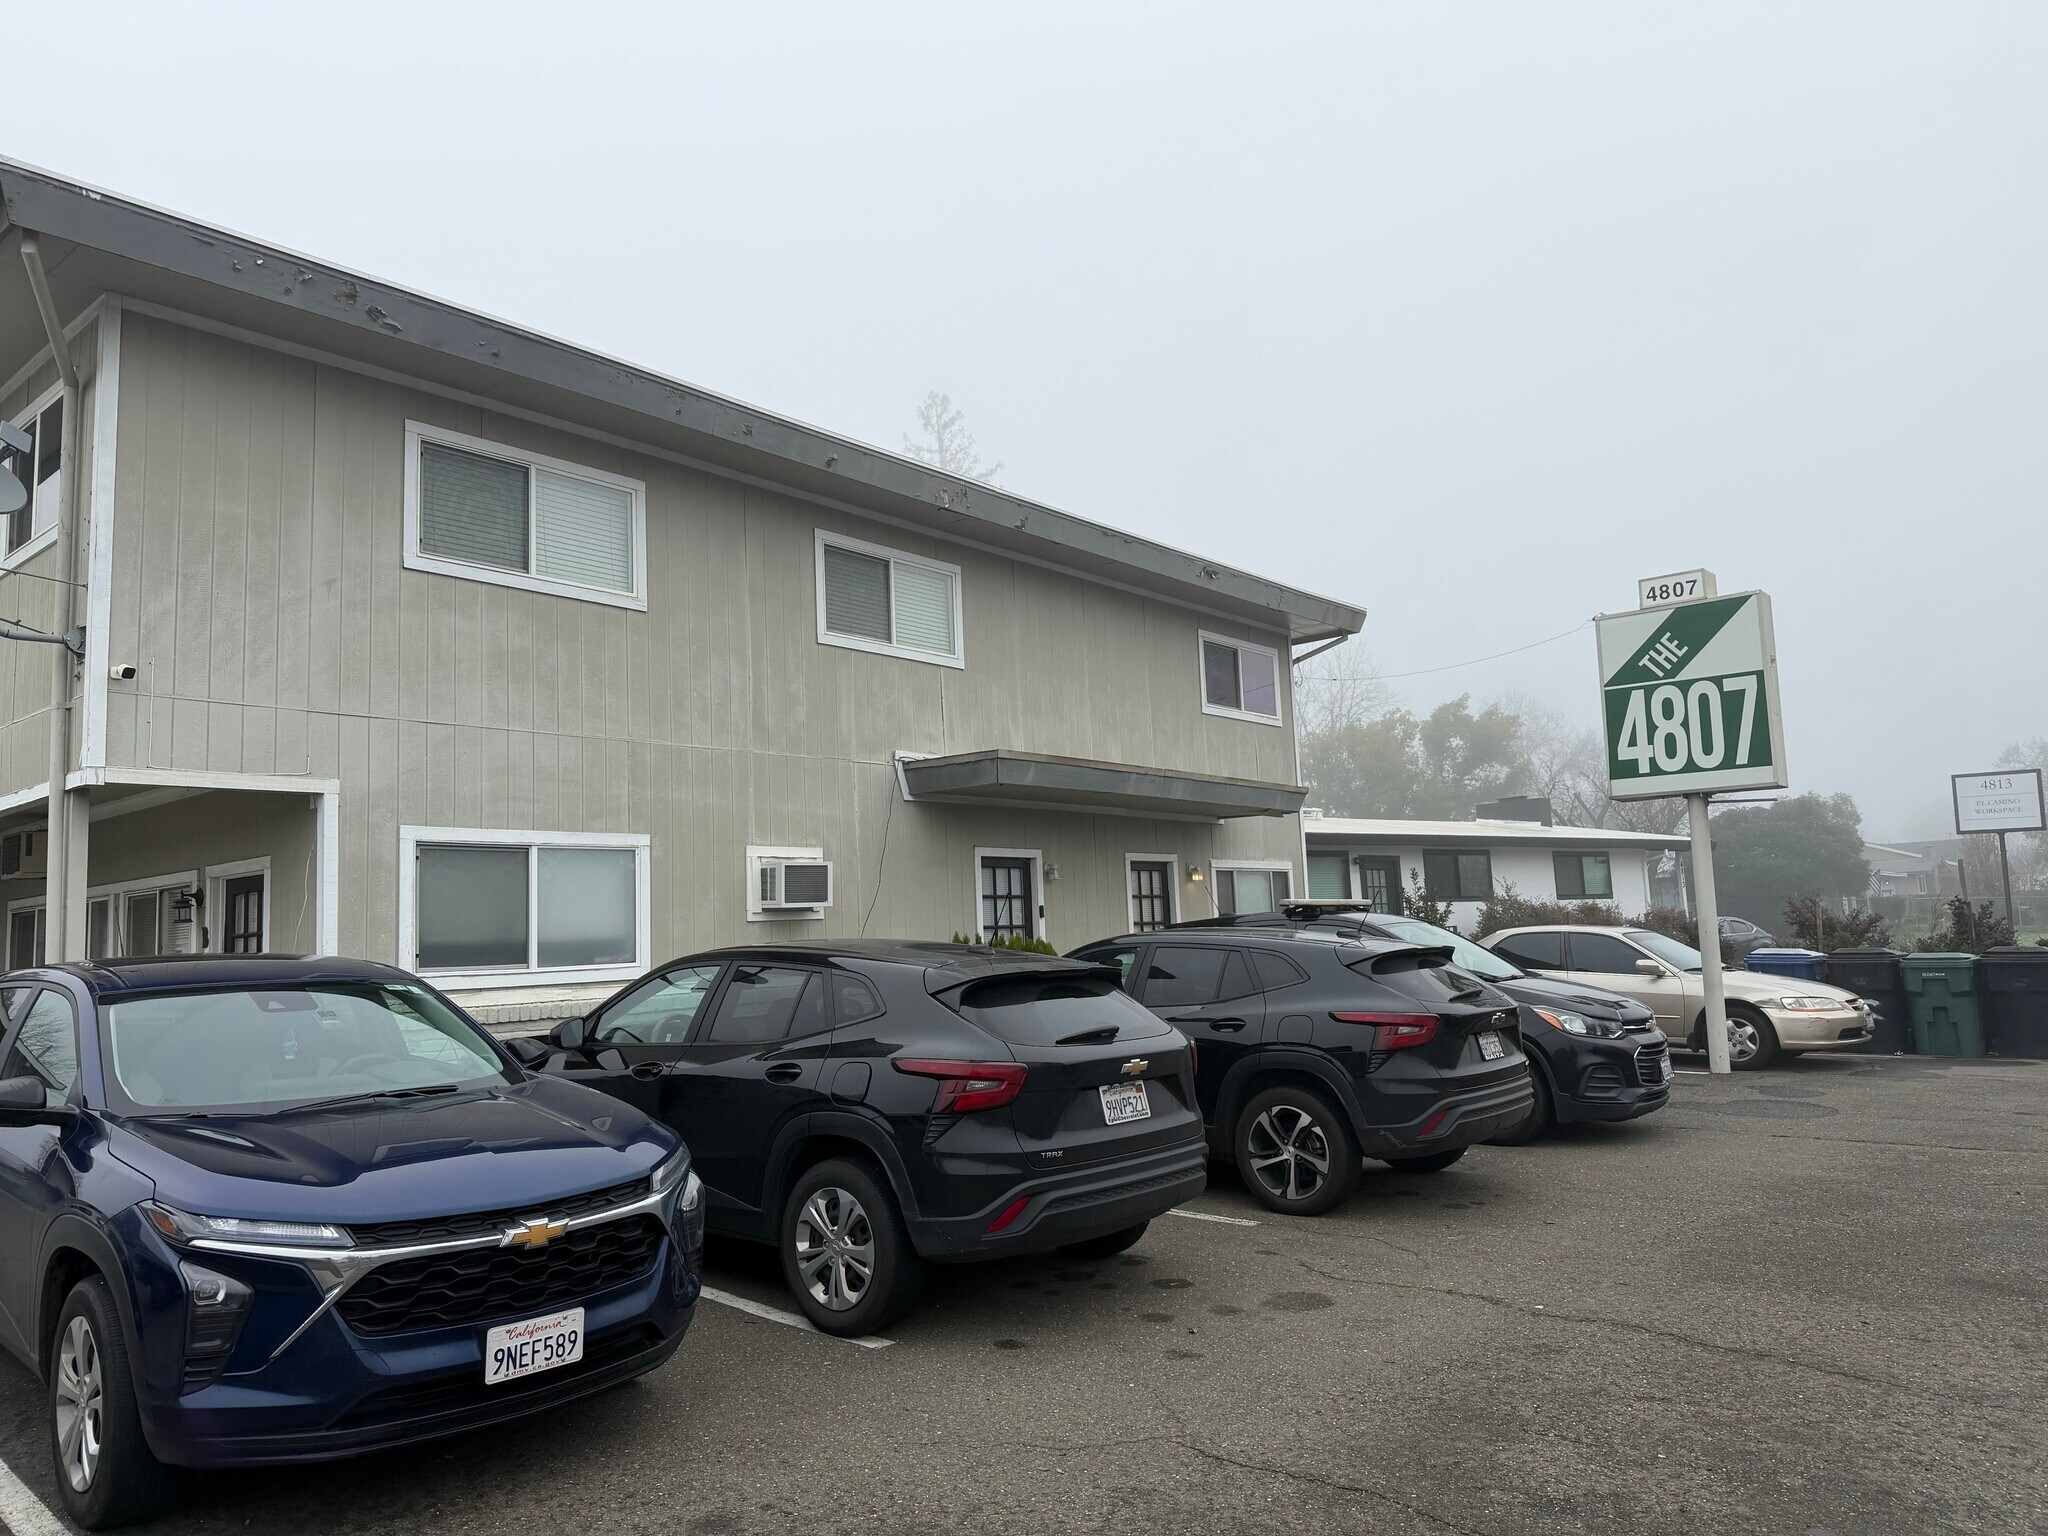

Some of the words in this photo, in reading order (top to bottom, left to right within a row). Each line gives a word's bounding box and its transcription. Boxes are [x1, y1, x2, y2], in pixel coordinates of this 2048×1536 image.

[1646, 579, 1698, 602] 4807
[1638, 631, 1689, 678] THE
[1617, 674, 1758, 774] 4807
[1981, 778, 2012, 790] 4813
[1974, 806, 2024, 815] WORKSPACE
[1987, 798, 2021, 806] CAMINO
[1105, 1095, 1146, 1118] 9HVP521
[1040, 1150, 1064, 1159] TRAX
[508, 1320, 567, 1341] California
[492, 1329, 578, 1376] 9NEF589
[510, 1360, 561, 1376] dmv.ca.gov
